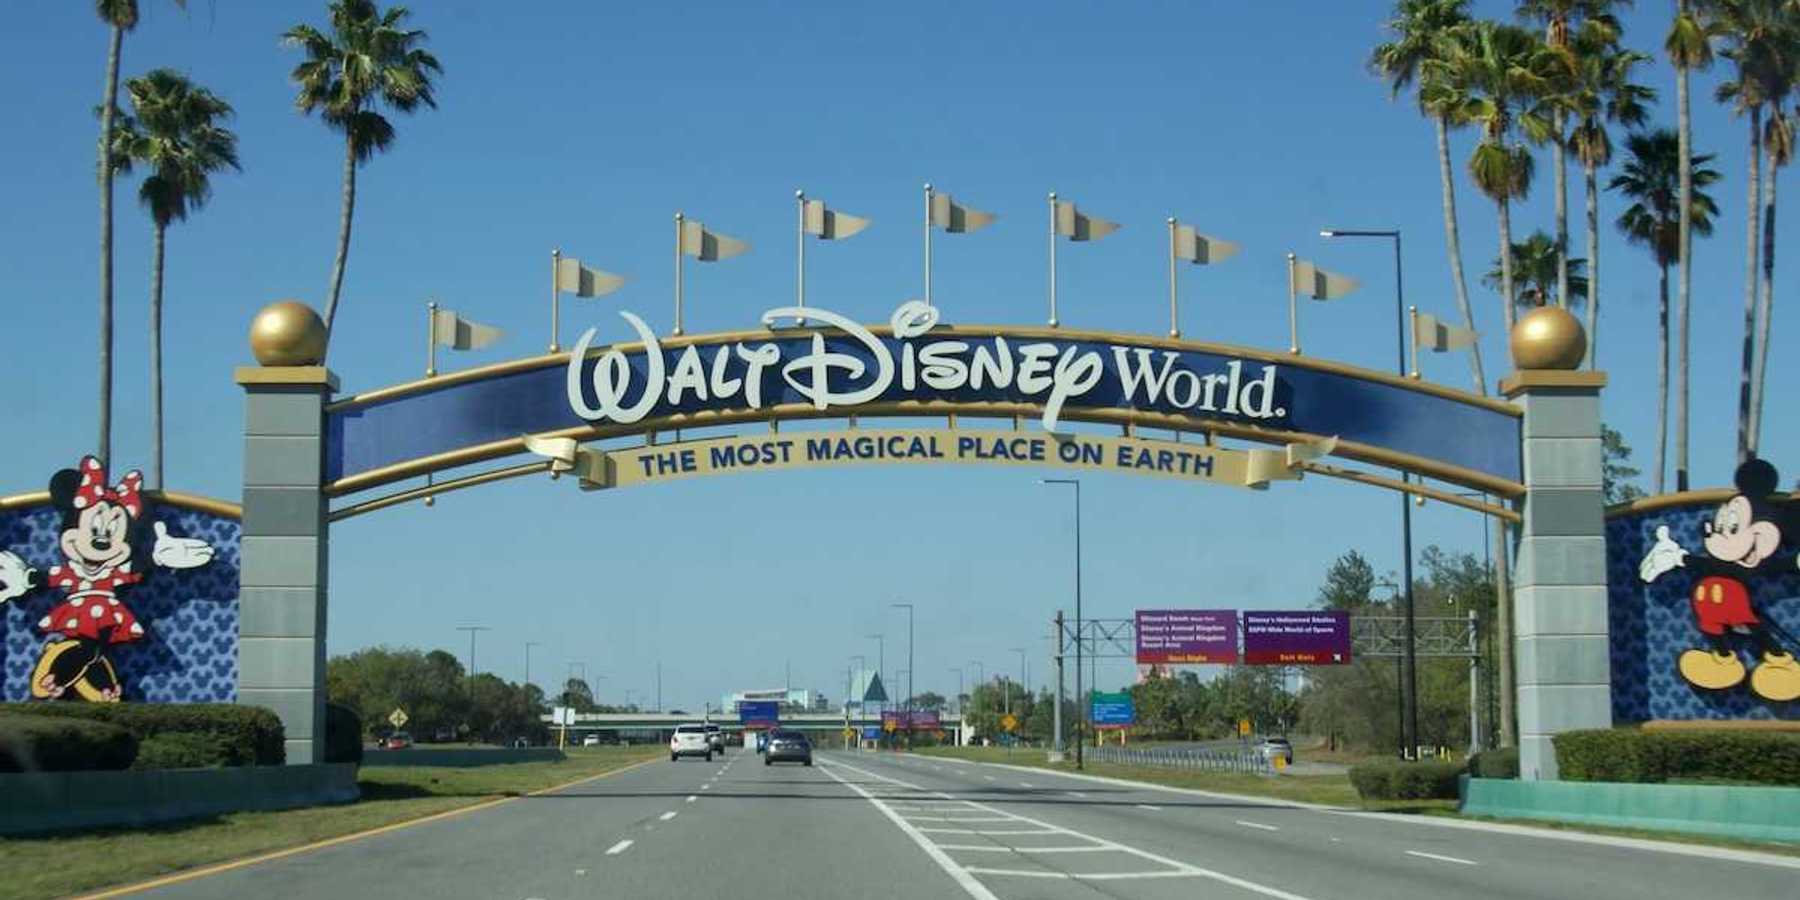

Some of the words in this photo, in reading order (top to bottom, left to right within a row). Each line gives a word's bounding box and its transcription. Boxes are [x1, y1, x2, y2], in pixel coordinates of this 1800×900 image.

[567, 311, 781, 424] WALT
[762, 301, 1103, 432] DISNEY
[1110, 346, 1287, 419] World.
[639, 450, 697, 476] THE
[711, 441, 793, 469] MOST
[807, 436, 944, 461] MAGICAL
[958, 437, 1046, 461] PLACE
[1059, 441, 1103, 465] ON
[1116, 446, 1214, 477] EARTH
